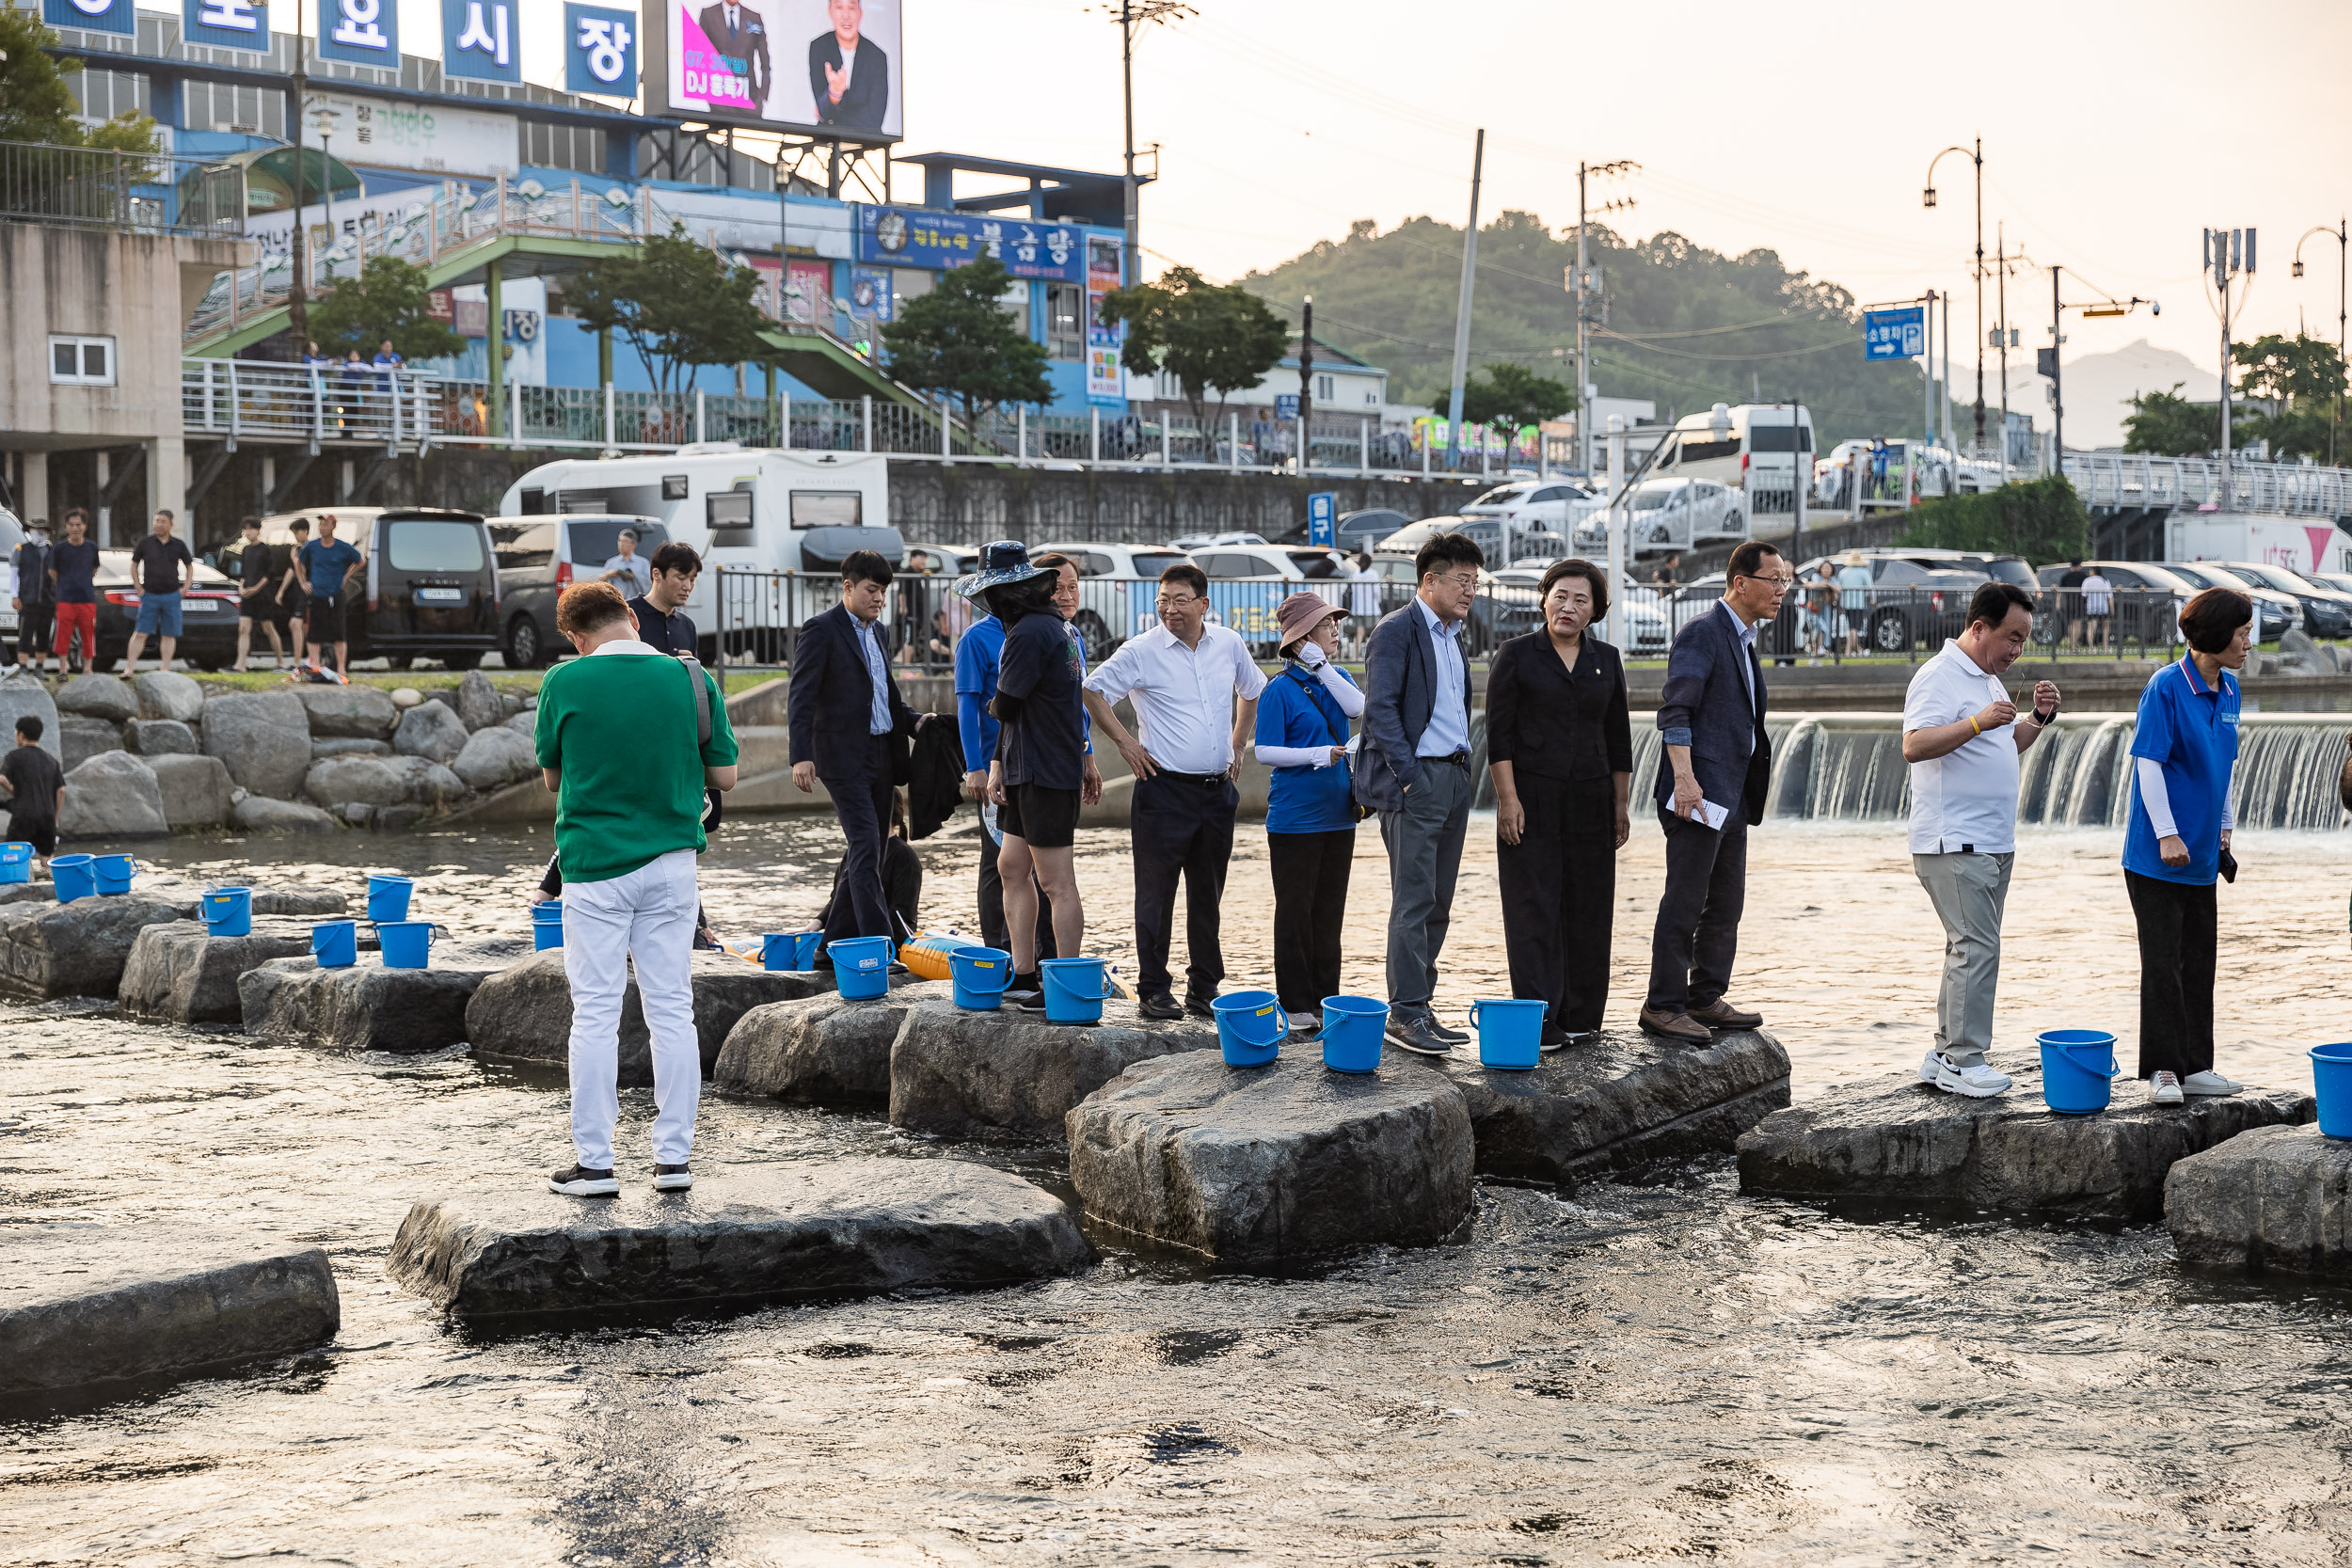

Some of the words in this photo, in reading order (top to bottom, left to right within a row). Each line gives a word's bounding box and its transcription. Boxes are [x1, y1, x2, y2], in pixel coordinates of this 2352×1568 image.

[685, 50, 706, 69] 07.
[685, 70, 708, 94] DJ
[1313, 498, 1329, 539] 출구
